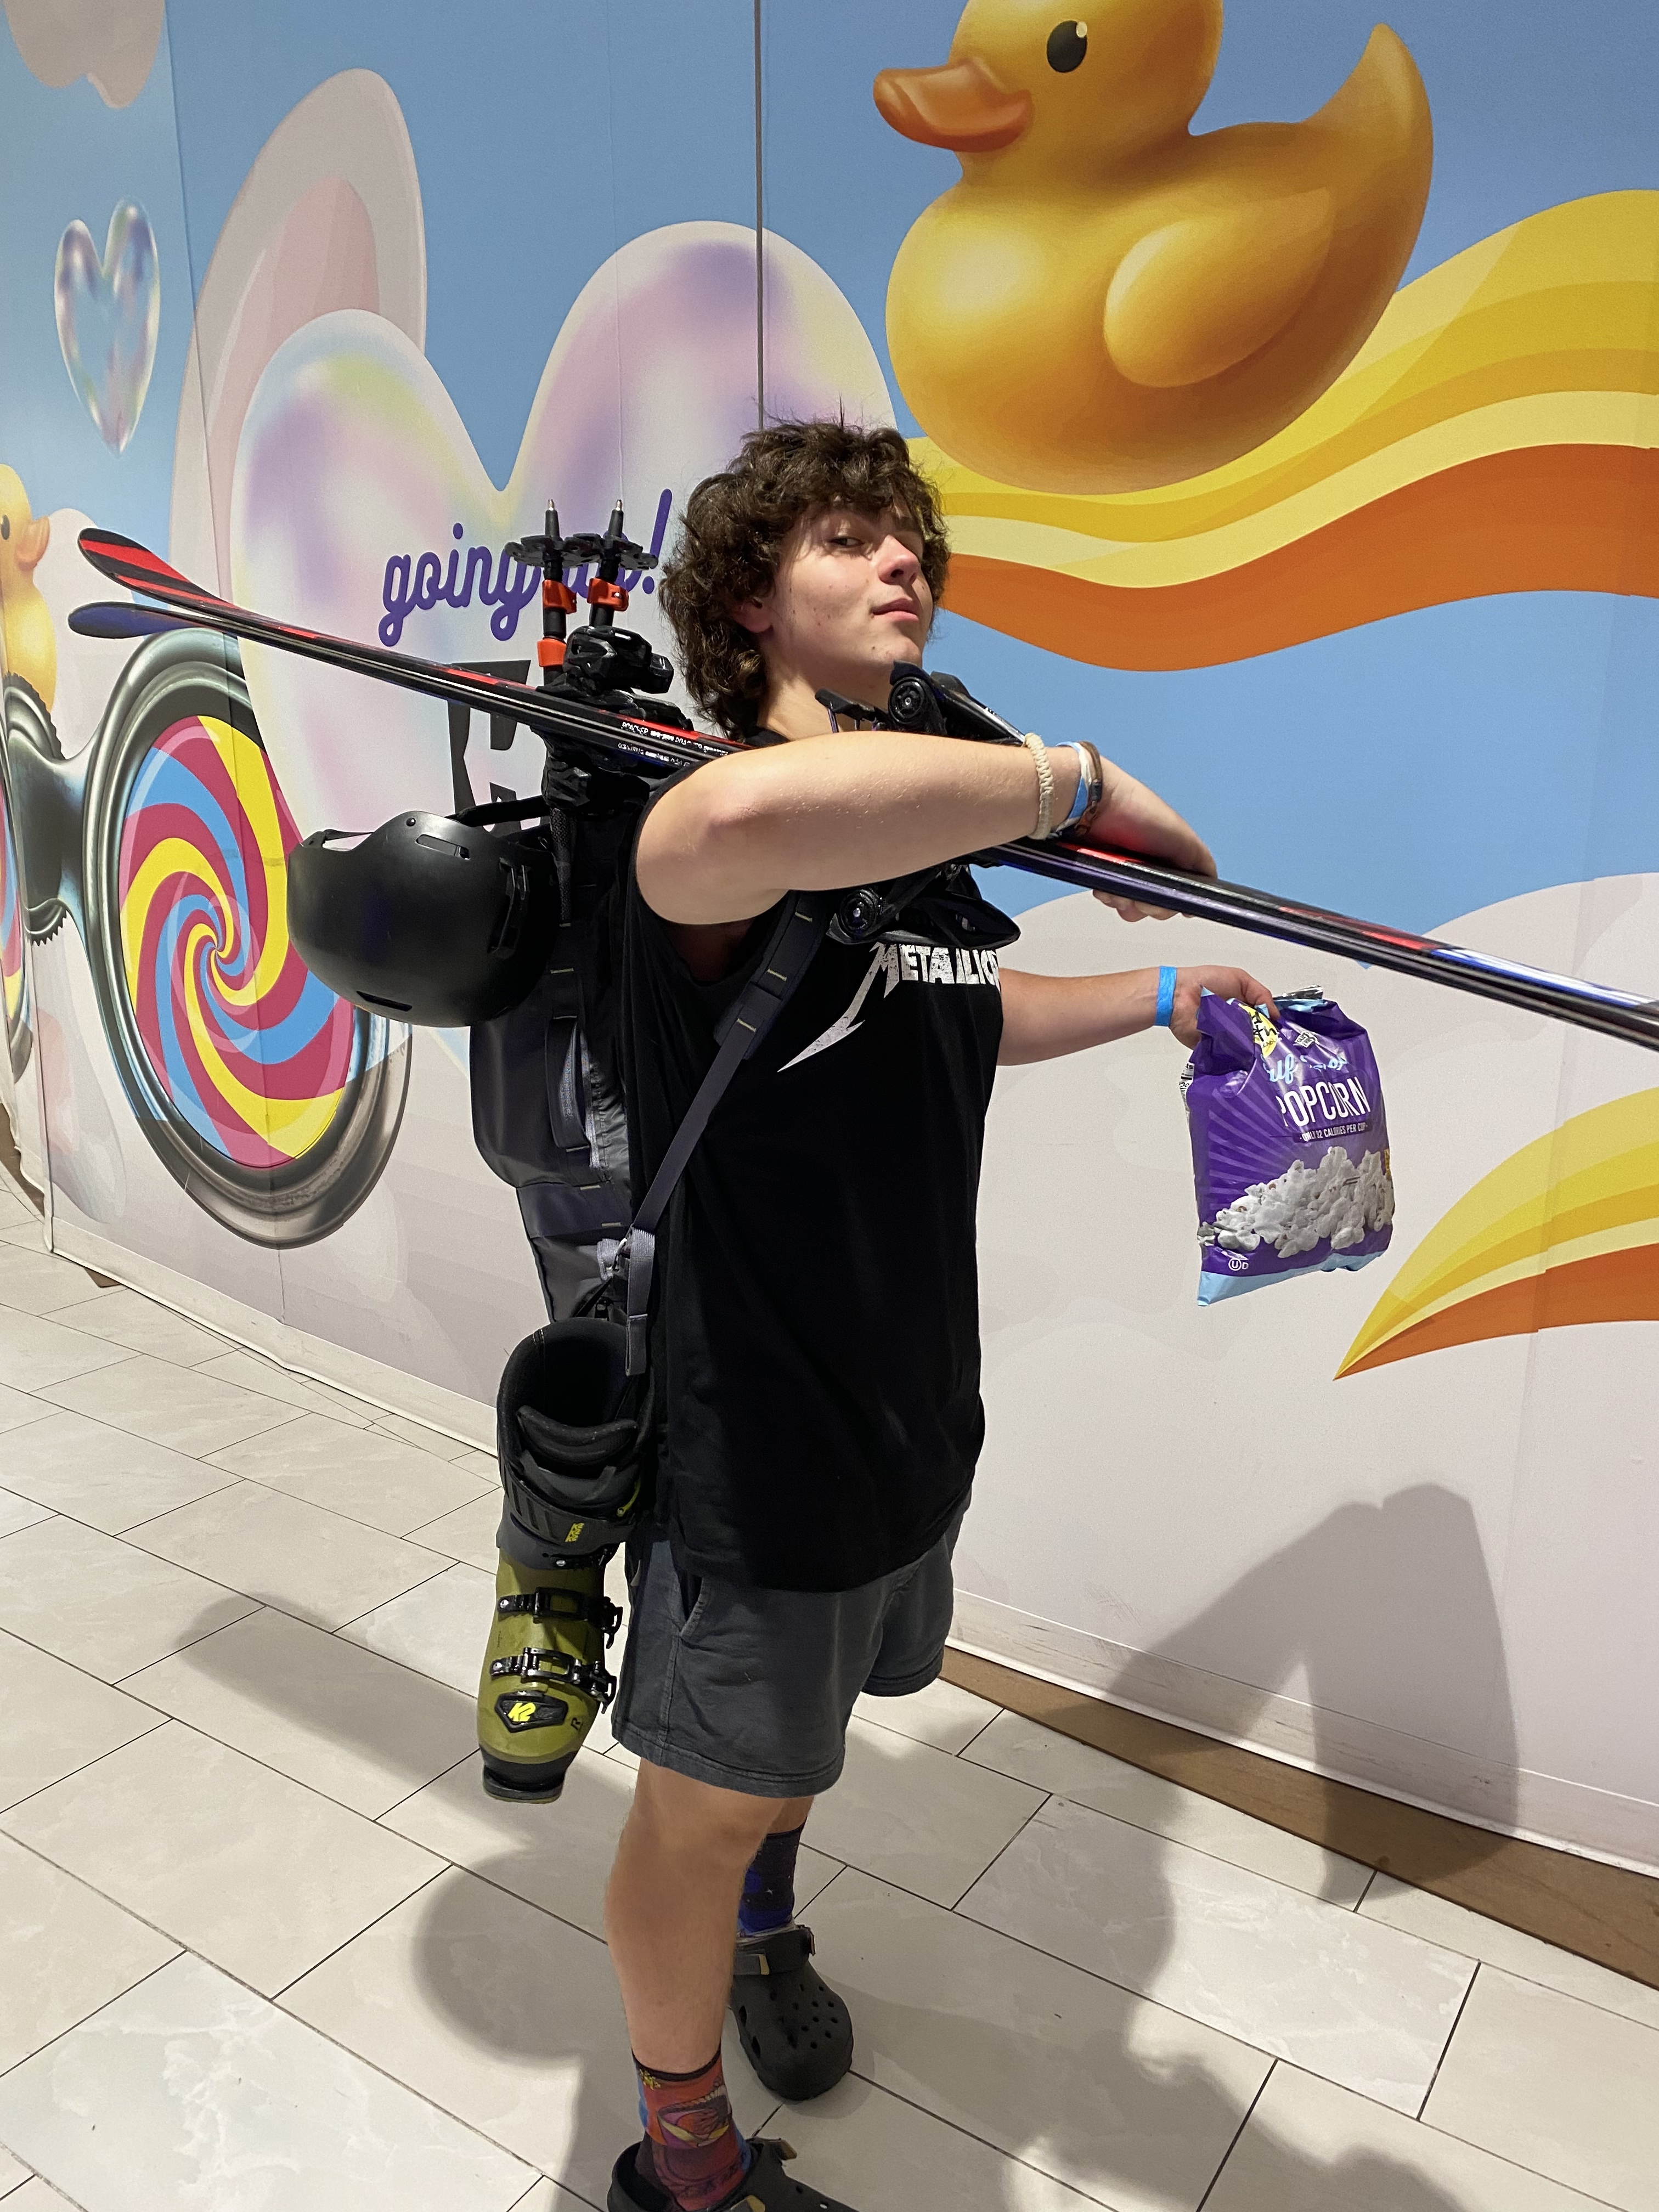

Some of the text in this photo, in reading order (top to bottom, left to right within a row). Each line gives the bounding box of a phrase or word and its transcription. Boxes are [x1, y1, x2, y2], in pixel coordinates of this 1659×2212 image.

[379, 523, 541, 647] going
[1276, 1076, 1371, 1127] POPCORN
[1346, 1124, 1357, 1133] PER
[507, 1702, 537, 1722] K2
